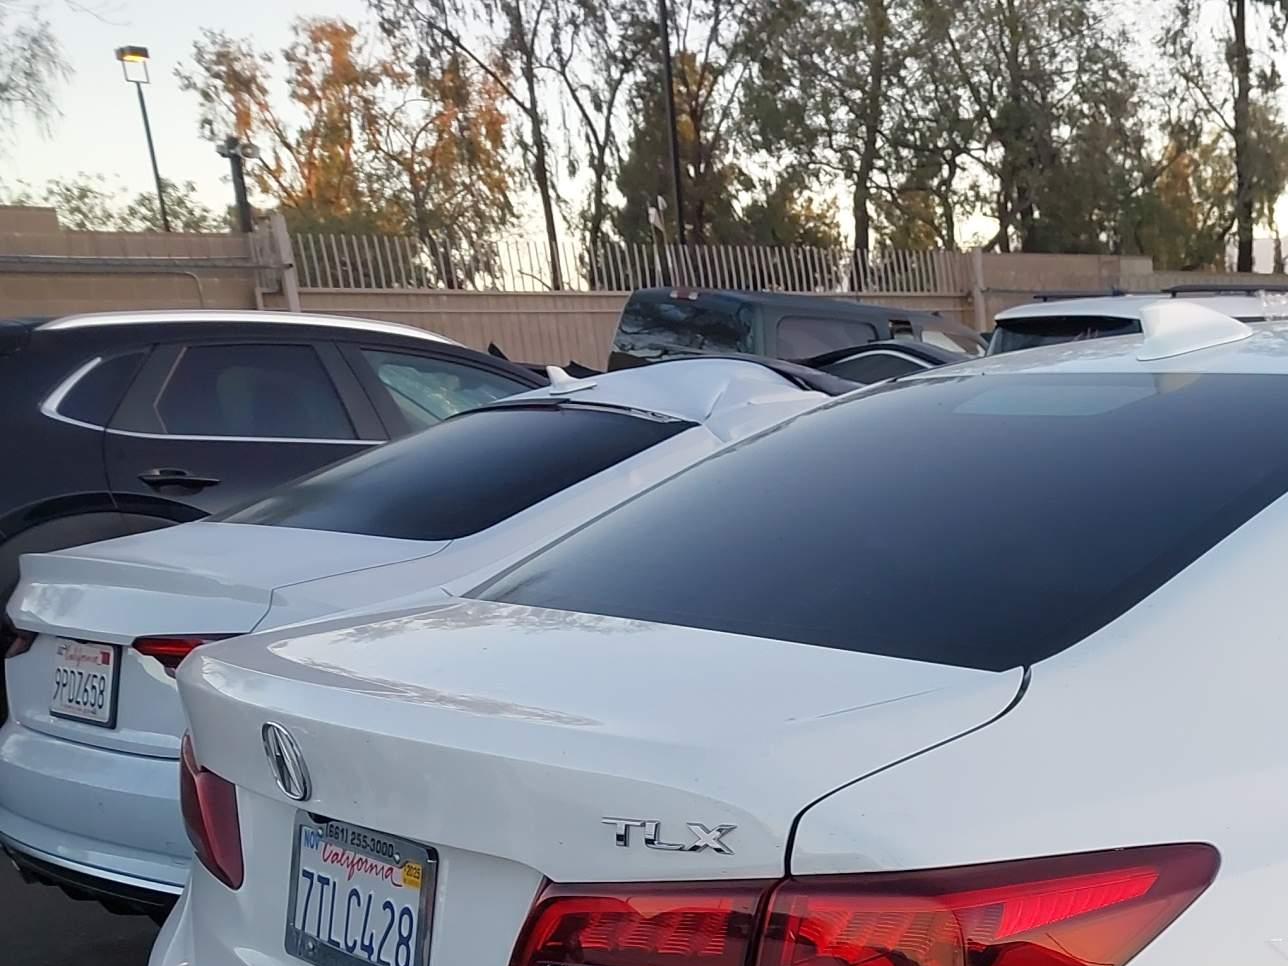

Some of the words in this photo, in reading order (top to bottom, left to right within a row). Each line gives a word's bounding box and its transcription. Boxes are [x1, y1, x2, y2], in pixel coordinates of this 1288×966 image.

[350, 831, 394, 858] 255-3000
[601, 816, 738, 855] TLX
[322, 841, 403, 887] California
